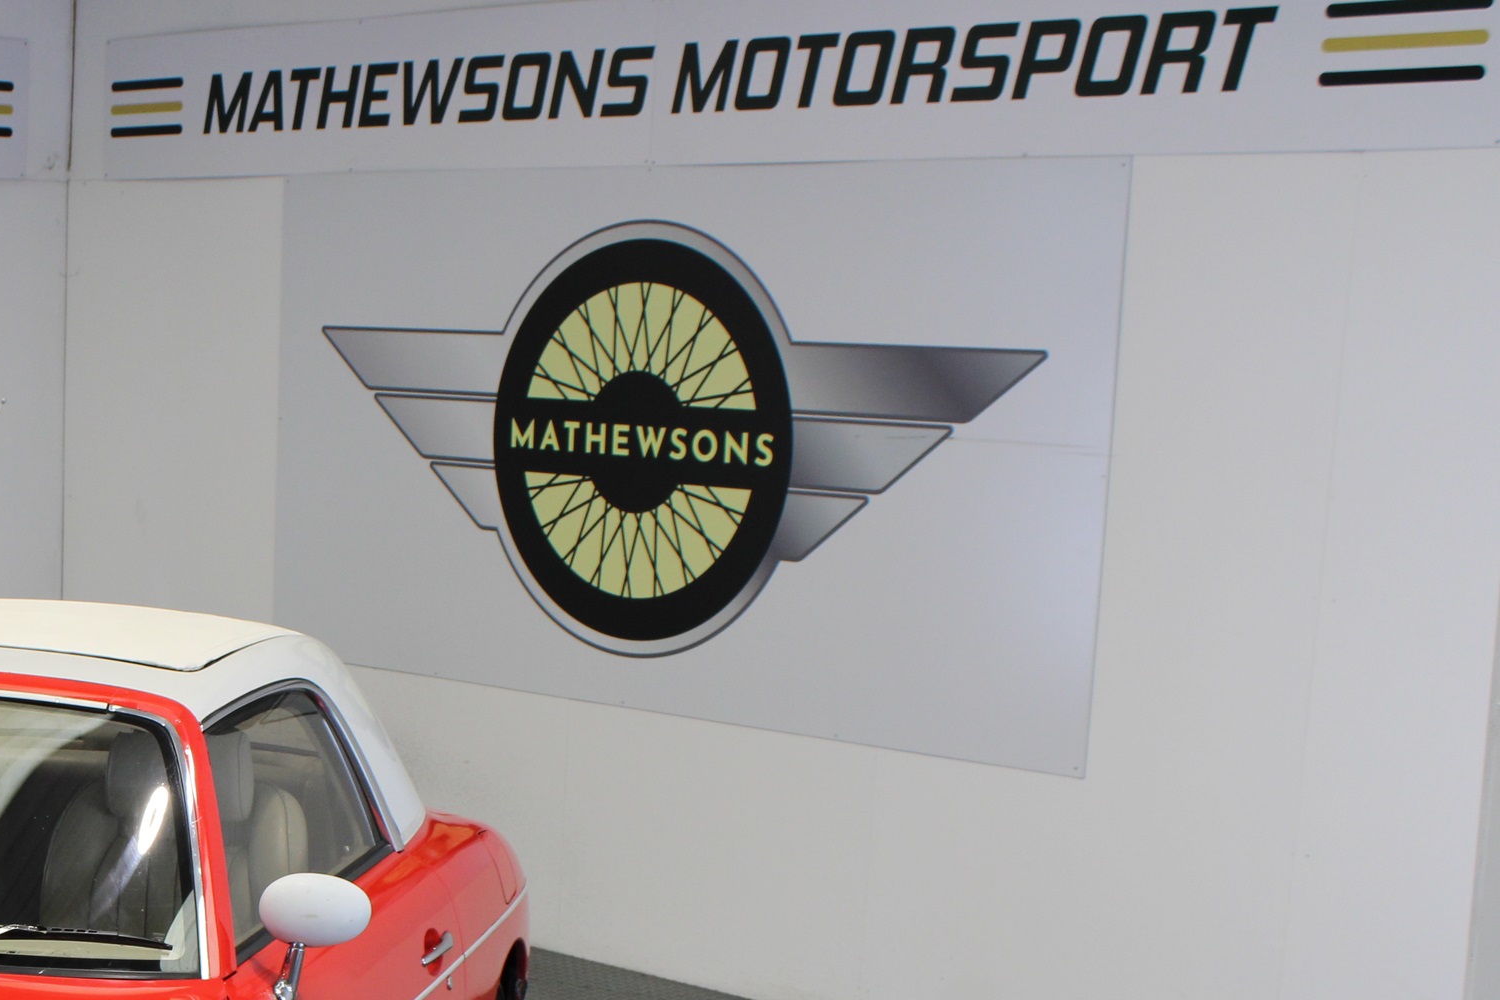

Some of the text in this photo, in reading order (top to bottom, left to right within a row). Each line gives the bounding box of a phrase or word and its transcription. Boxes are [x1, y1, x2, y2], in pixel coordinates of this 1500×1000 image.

[203, 6, 1278, 134] MATHEWSONS MOTORSPORT
[511, 418, 774, 467] MATHEWSONS
